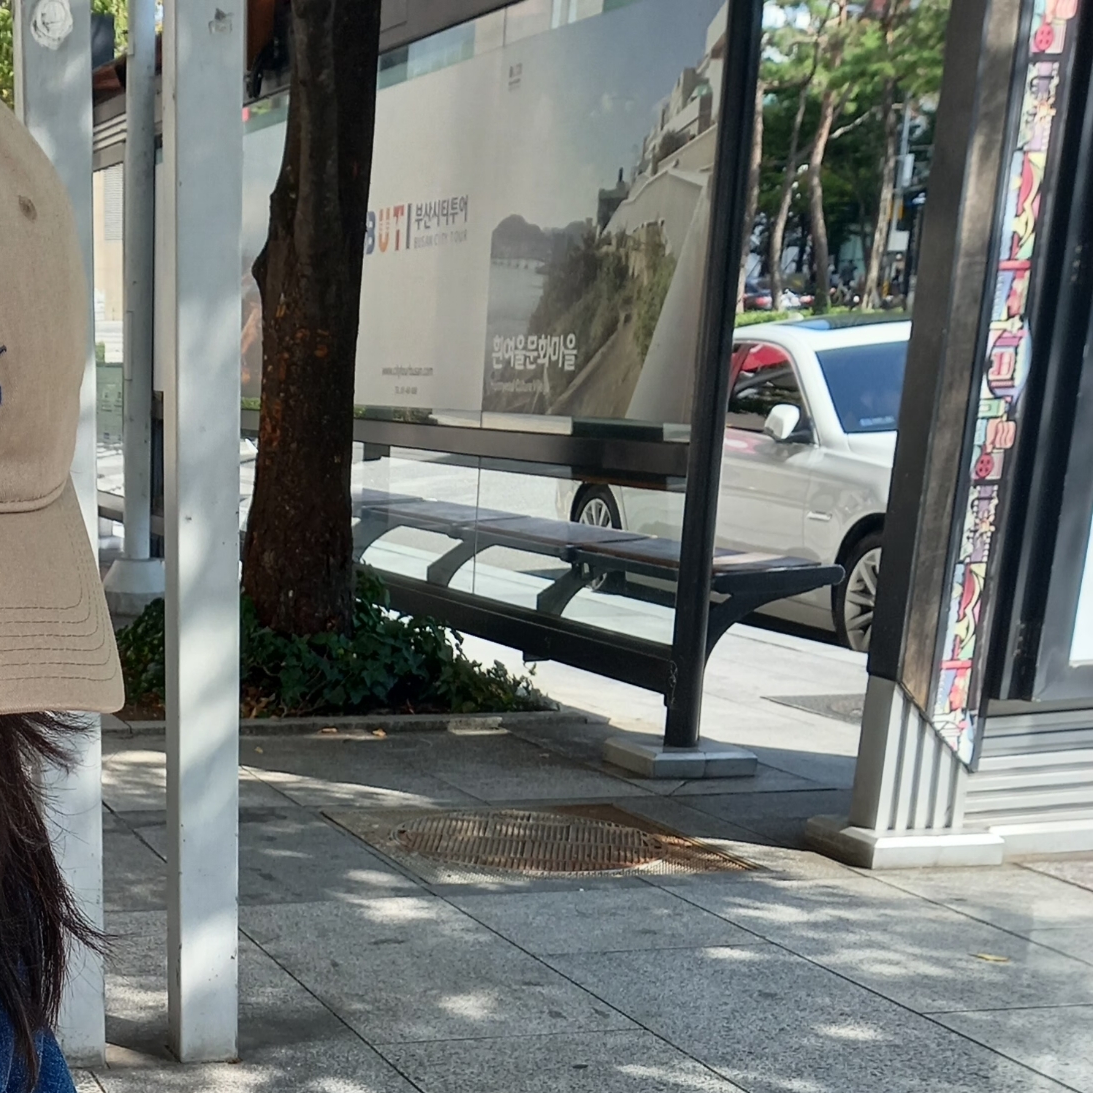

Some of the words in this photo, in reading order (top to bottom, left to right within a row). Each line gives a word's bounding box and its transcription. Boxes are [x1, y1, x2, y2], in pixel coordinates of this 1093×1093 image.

[365, 203, 413, 255] BUTI
[414, 194, 468, 230] 부산시티투어
[491, 333, 577, 371] 흰여울문화마을
